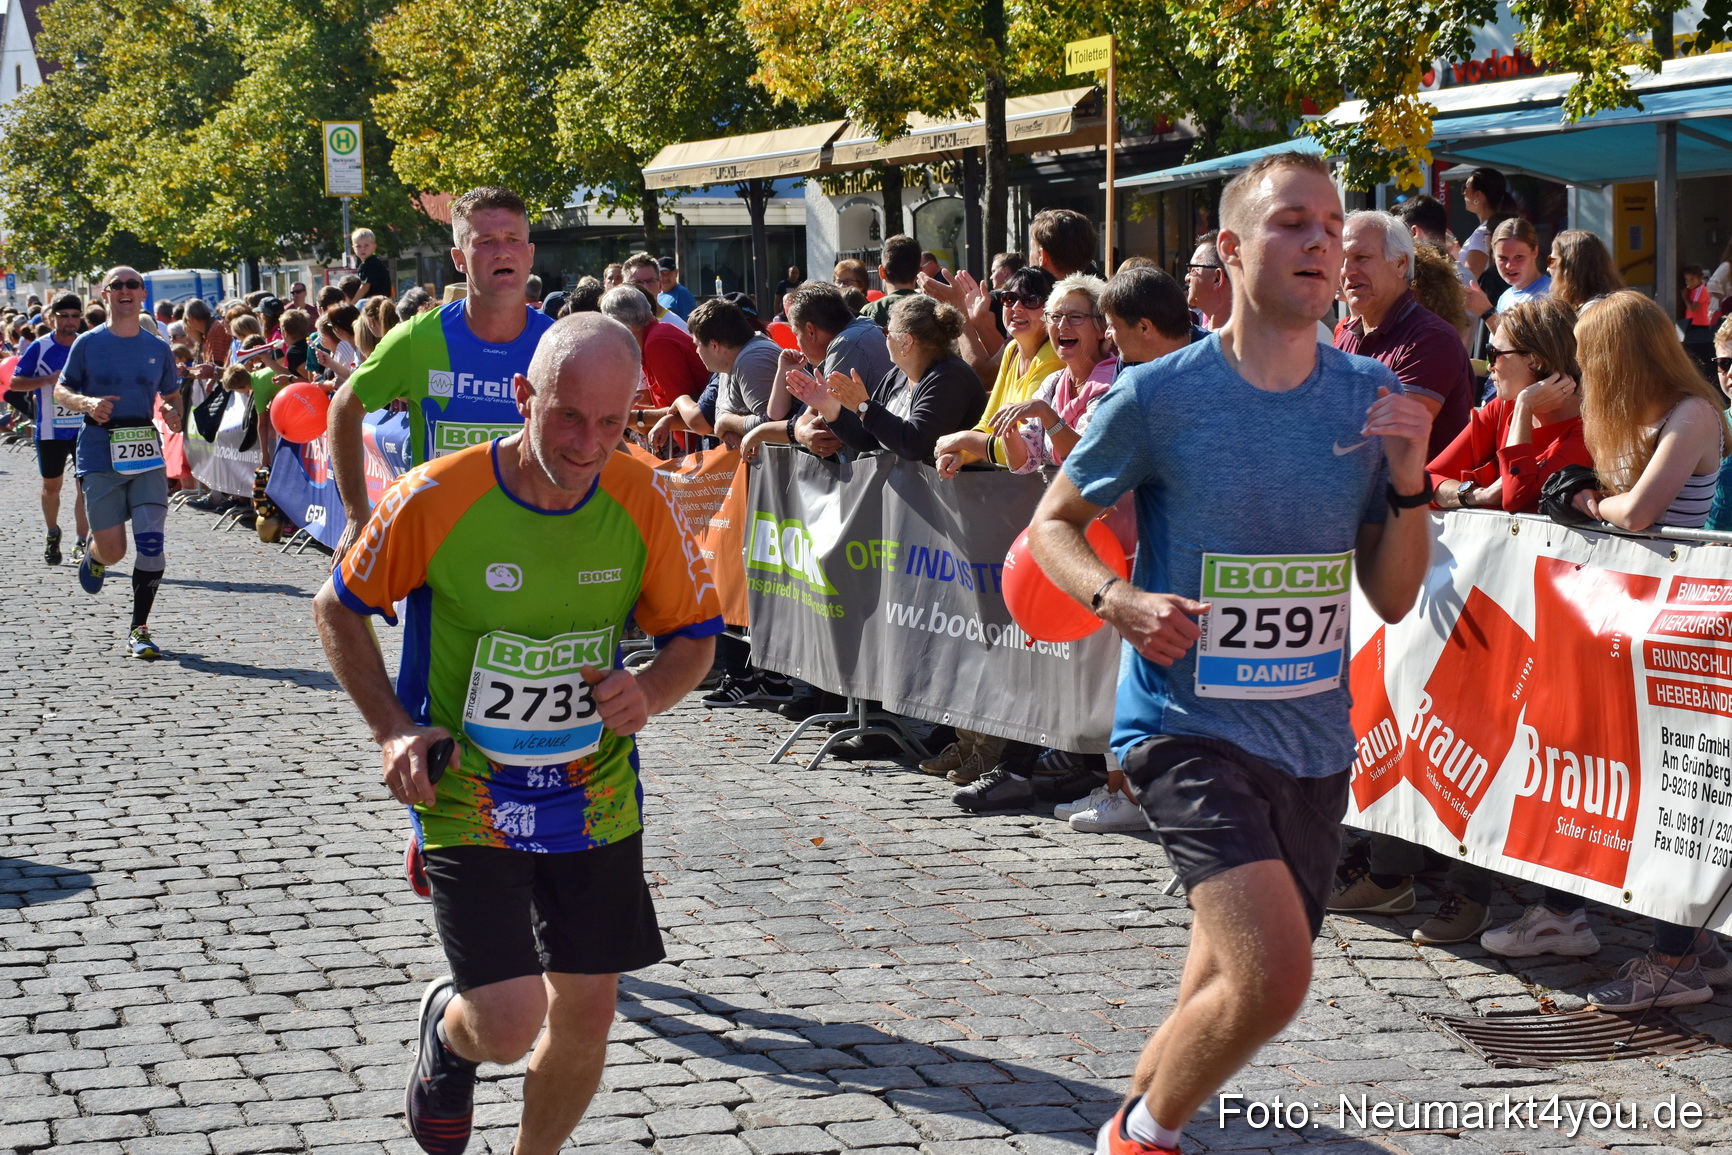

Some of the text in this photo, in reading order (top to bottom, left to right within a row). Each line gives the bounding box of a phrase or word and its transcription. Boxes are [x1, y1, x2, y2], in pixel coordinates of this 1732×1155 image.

[1074, 48, 1108, 64] Toiletten
[1452, 45, 1557, 84] vodafo
[336, 133, 350, 149] H
[115, 428, 153, 441] BOCK
[445, 429, 524, 444] BOC
[118, 443, 155, 459] 2789
[695, 487, 711, 497] und
[700, 502, 714, 511] was
[350, 466, 440, 581] BOCK
[579, 568, 622, 584] BOCK
[1215, 561, 1346, 593] BOCK
[1219, 603, 1339, 649] 2597
[488, 636, 604, 676] BOCK
[1610, 633, 1622, 658] Seit
[1652, 647, 1732, 676] RUNDSCHLI
[1236, 661, 1317, 682] DANIEL
[1511, 657, 1534, 700] Seit 1929
[484, 681, 597, 723] 2733
[513, 734, 571, 750] WERNER
[1404, 689, 1489, 799] Braun
[1661, 726, 1731, 758] Braun GmbH
[1369, 764, 1387, 781] Sicher
[1512, 722, 1631, 822] Braun
[1662, 750, 1731, 787] Am Grünberg
[1425, 766, 1473, 821] Sicher ist sicher
[1661, 773, 1698, 799] D-92318
[1555, 816, 1634, 853] Sicher ist sicher
[1658, 806, 1732, 844] Tel. 09181 / 230
[1654, 830, 1672, 852] Fax
[1674, 836, 1702, 860] 09181
[1705, 844, 1711, 862] /
